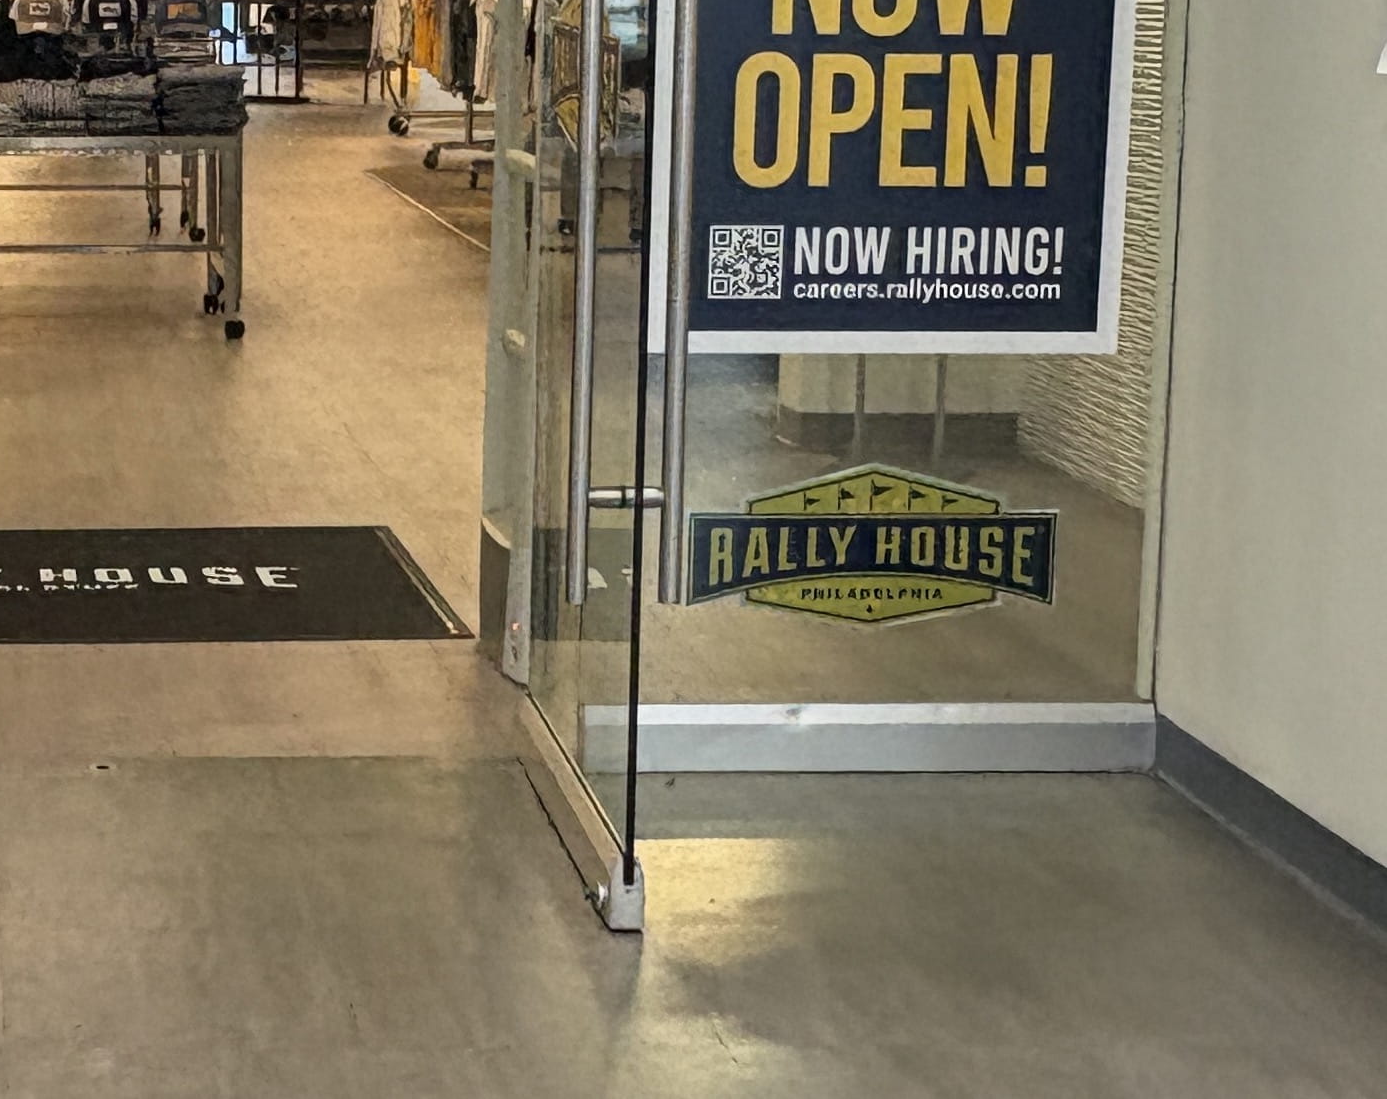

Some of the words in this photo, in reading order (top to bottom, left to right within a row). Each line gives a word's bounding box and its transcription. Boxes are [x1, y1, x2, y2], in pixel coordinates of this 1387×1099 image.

[732, 50, 1053, 189] OPEN!
[792, 225, 891, 275] NOW
[905, 225, 1065, 276] HIRING!
[792, 276, 1061, 304] careers.rallyhouse.com
[38, 566, 299, 589] HOUSE
[708, 523, 858, 587] RALLY
[874, 524, 1035, 587] HOUSE
